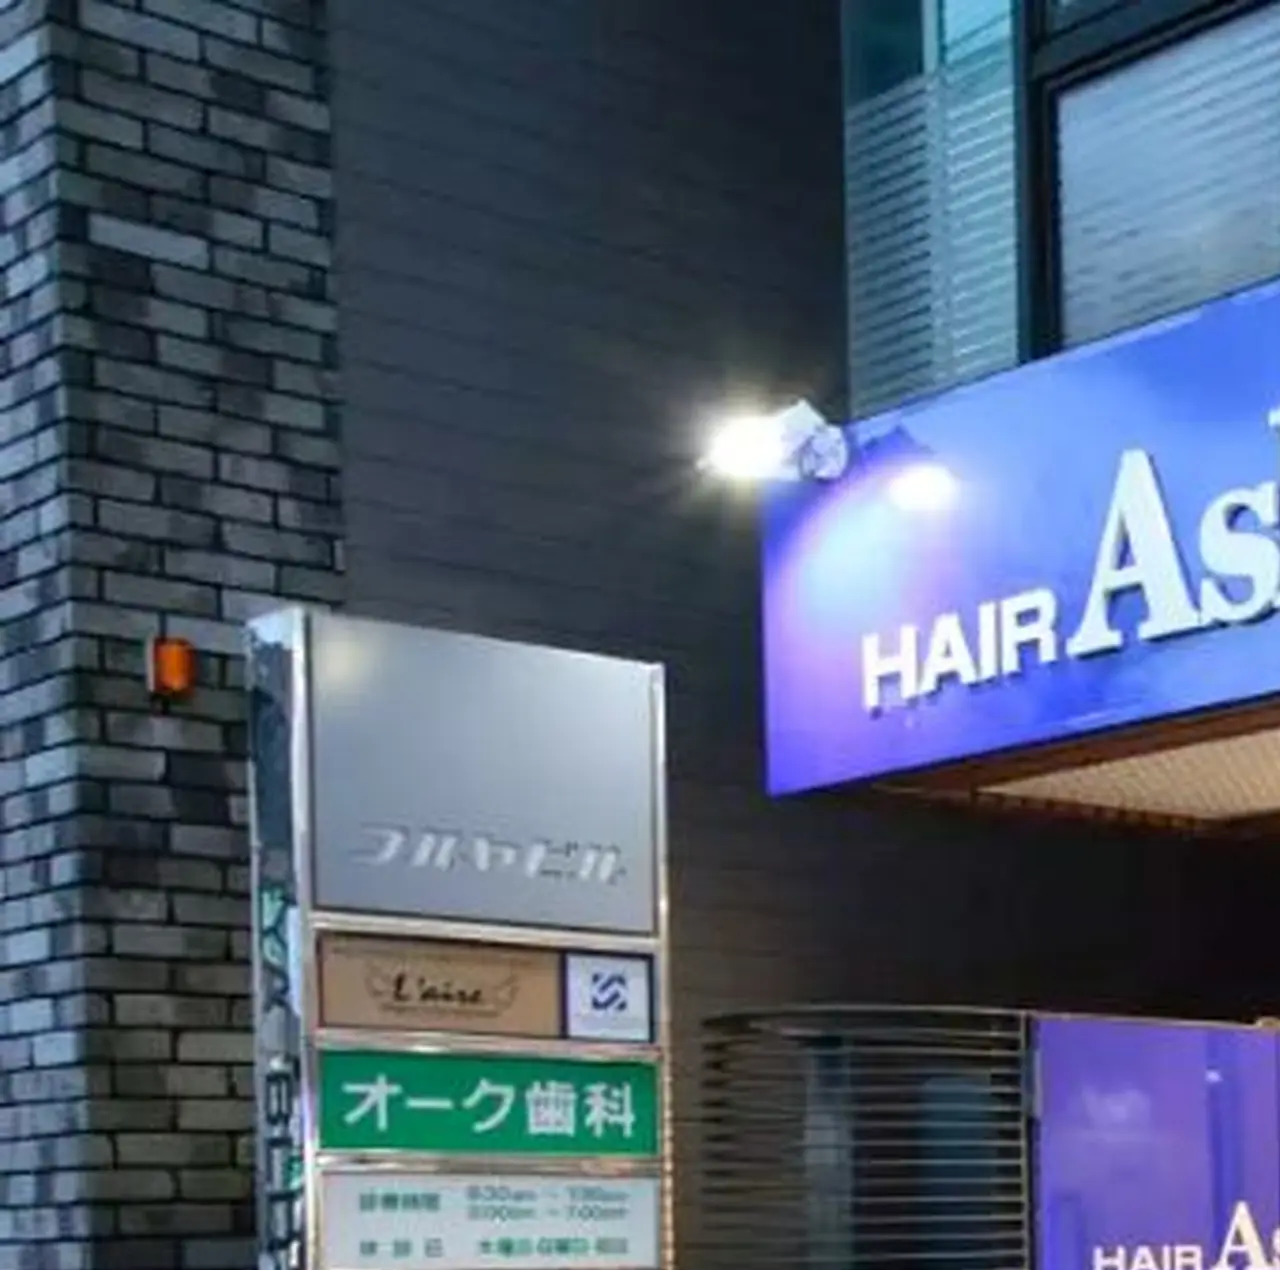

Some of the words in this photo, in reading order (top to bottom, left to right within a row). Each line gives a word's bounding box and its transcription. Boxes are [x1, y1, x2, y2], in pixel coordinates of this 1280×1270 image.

[861, 586, 1059, 712] HAIR
[342, 1073, 636, 1138] オーク歯科
